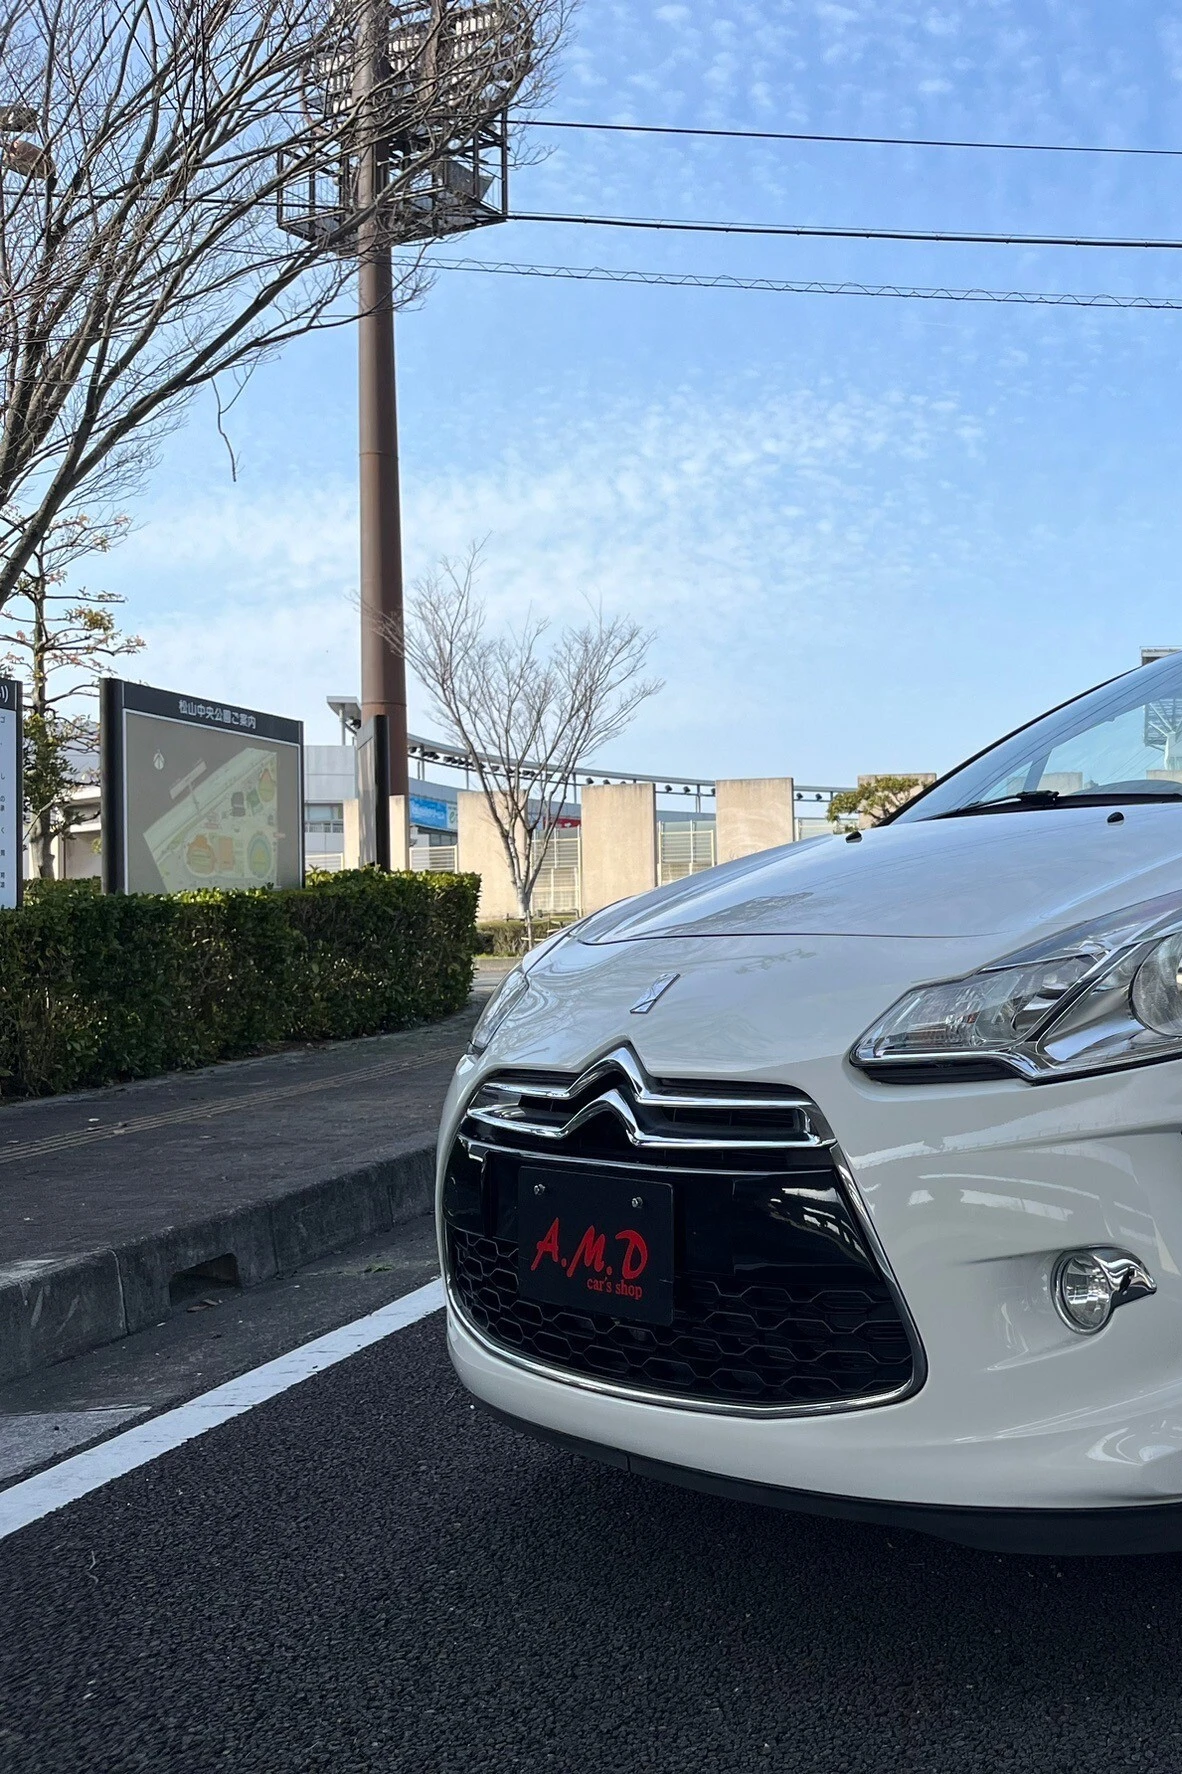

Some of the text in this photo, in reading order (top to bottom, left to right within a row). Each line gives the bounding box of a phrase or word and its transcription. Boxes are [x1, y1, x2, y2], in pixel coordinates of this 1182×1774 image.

[530, 1217, 648, 1279] A.M.D
[586, 1277, 643, 1300] car's shop
